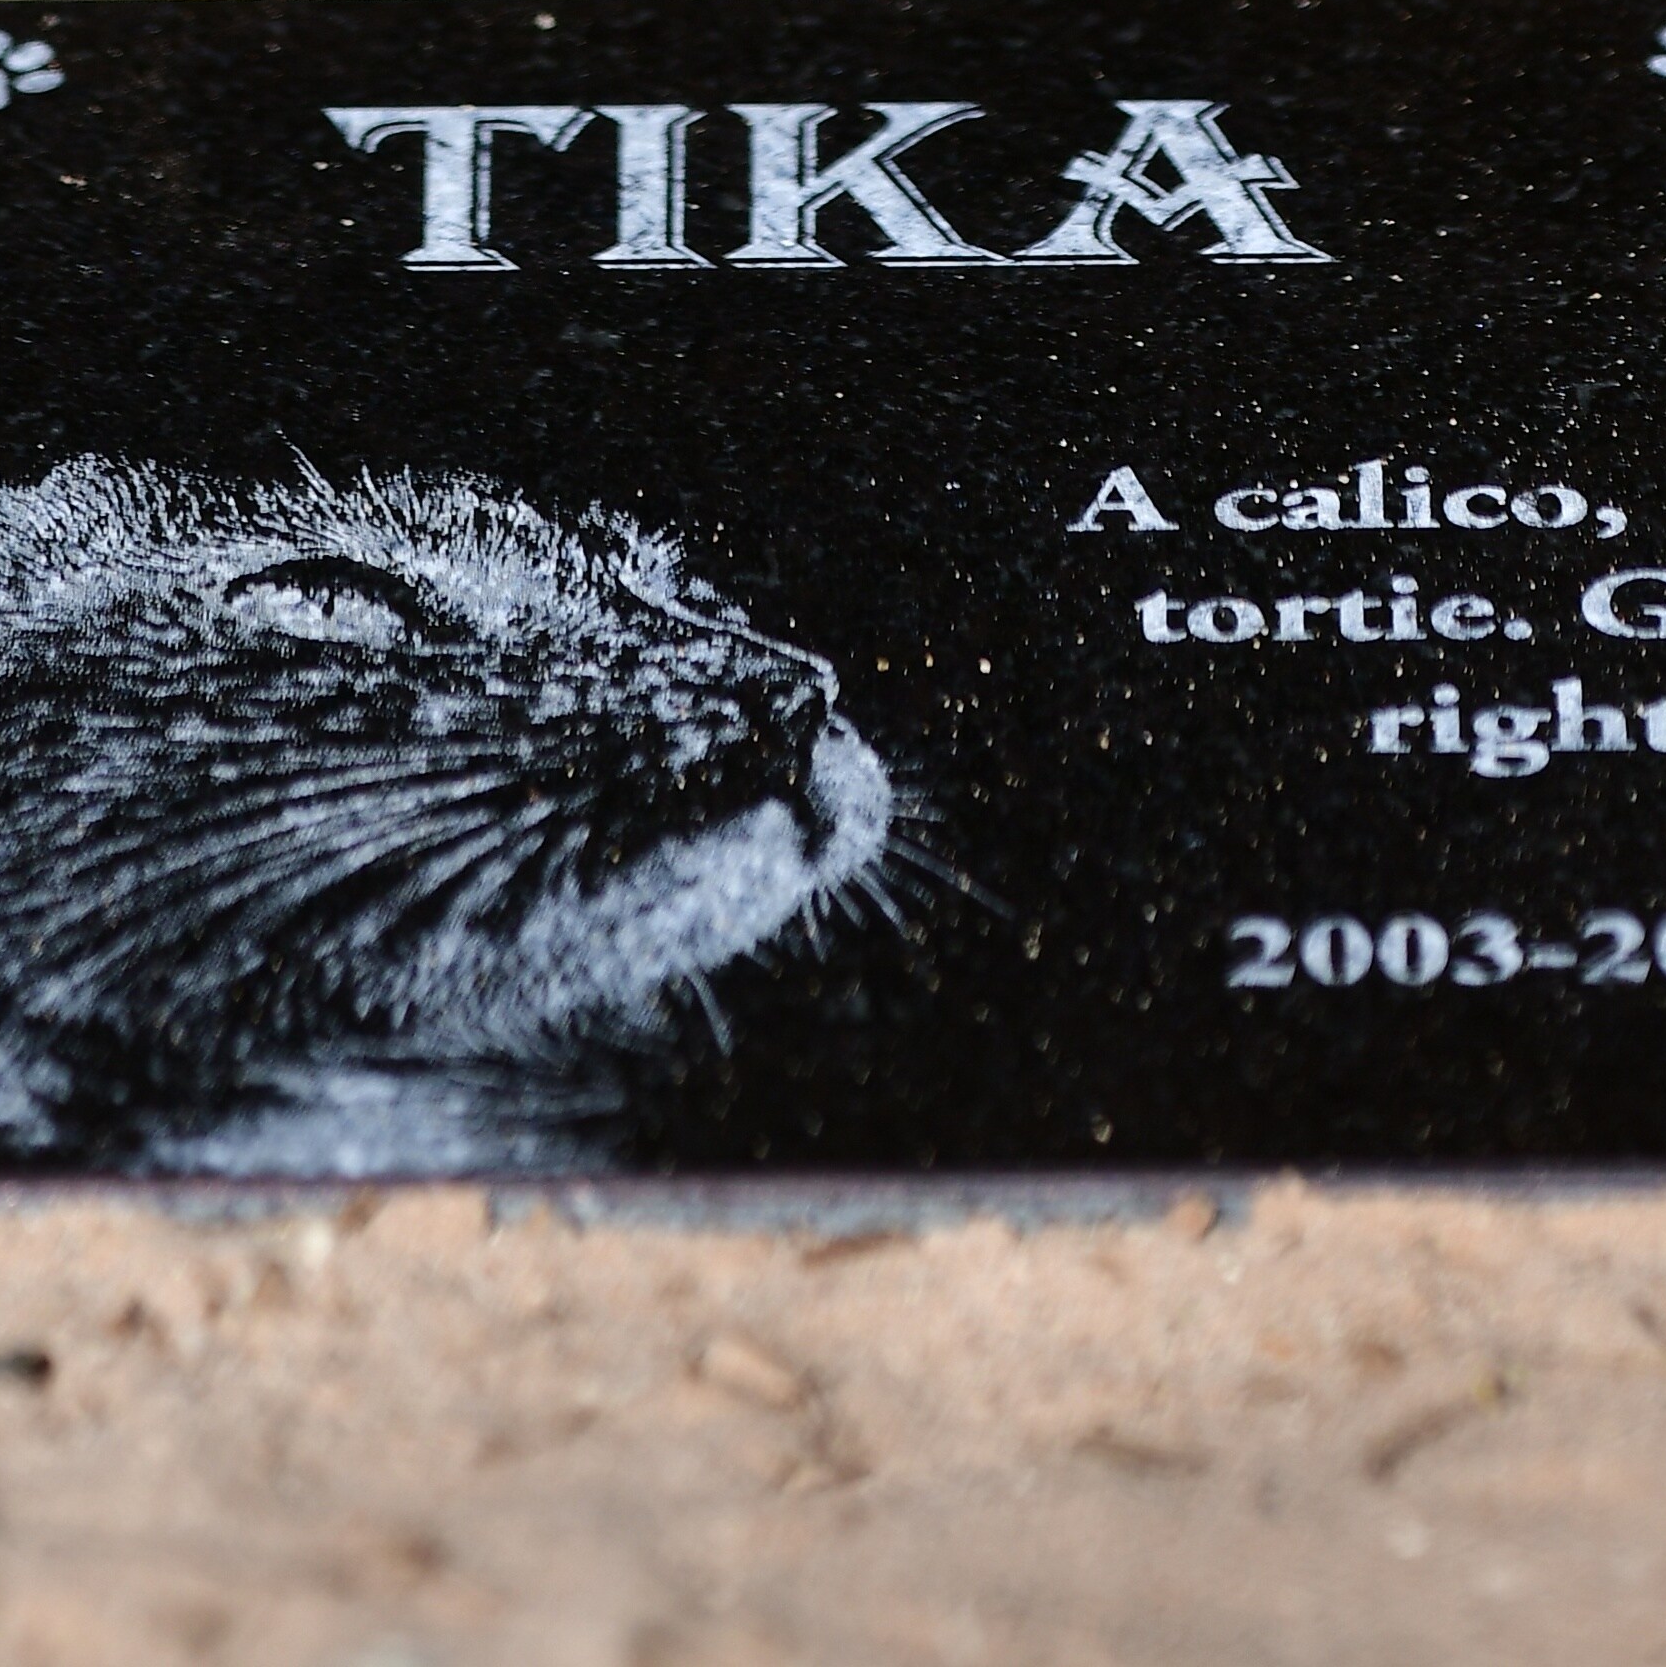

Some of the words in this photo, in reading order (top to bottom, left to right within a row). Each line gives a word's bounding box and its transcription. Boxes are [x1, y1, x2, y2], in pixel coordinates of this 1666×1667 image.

[323, 98, 1334, 272] TIKA
[1065, 465, 1179, 533] A
[1212, 459, 1628, 539] calico,
[1133, 572, 1533, 645] tortie.
